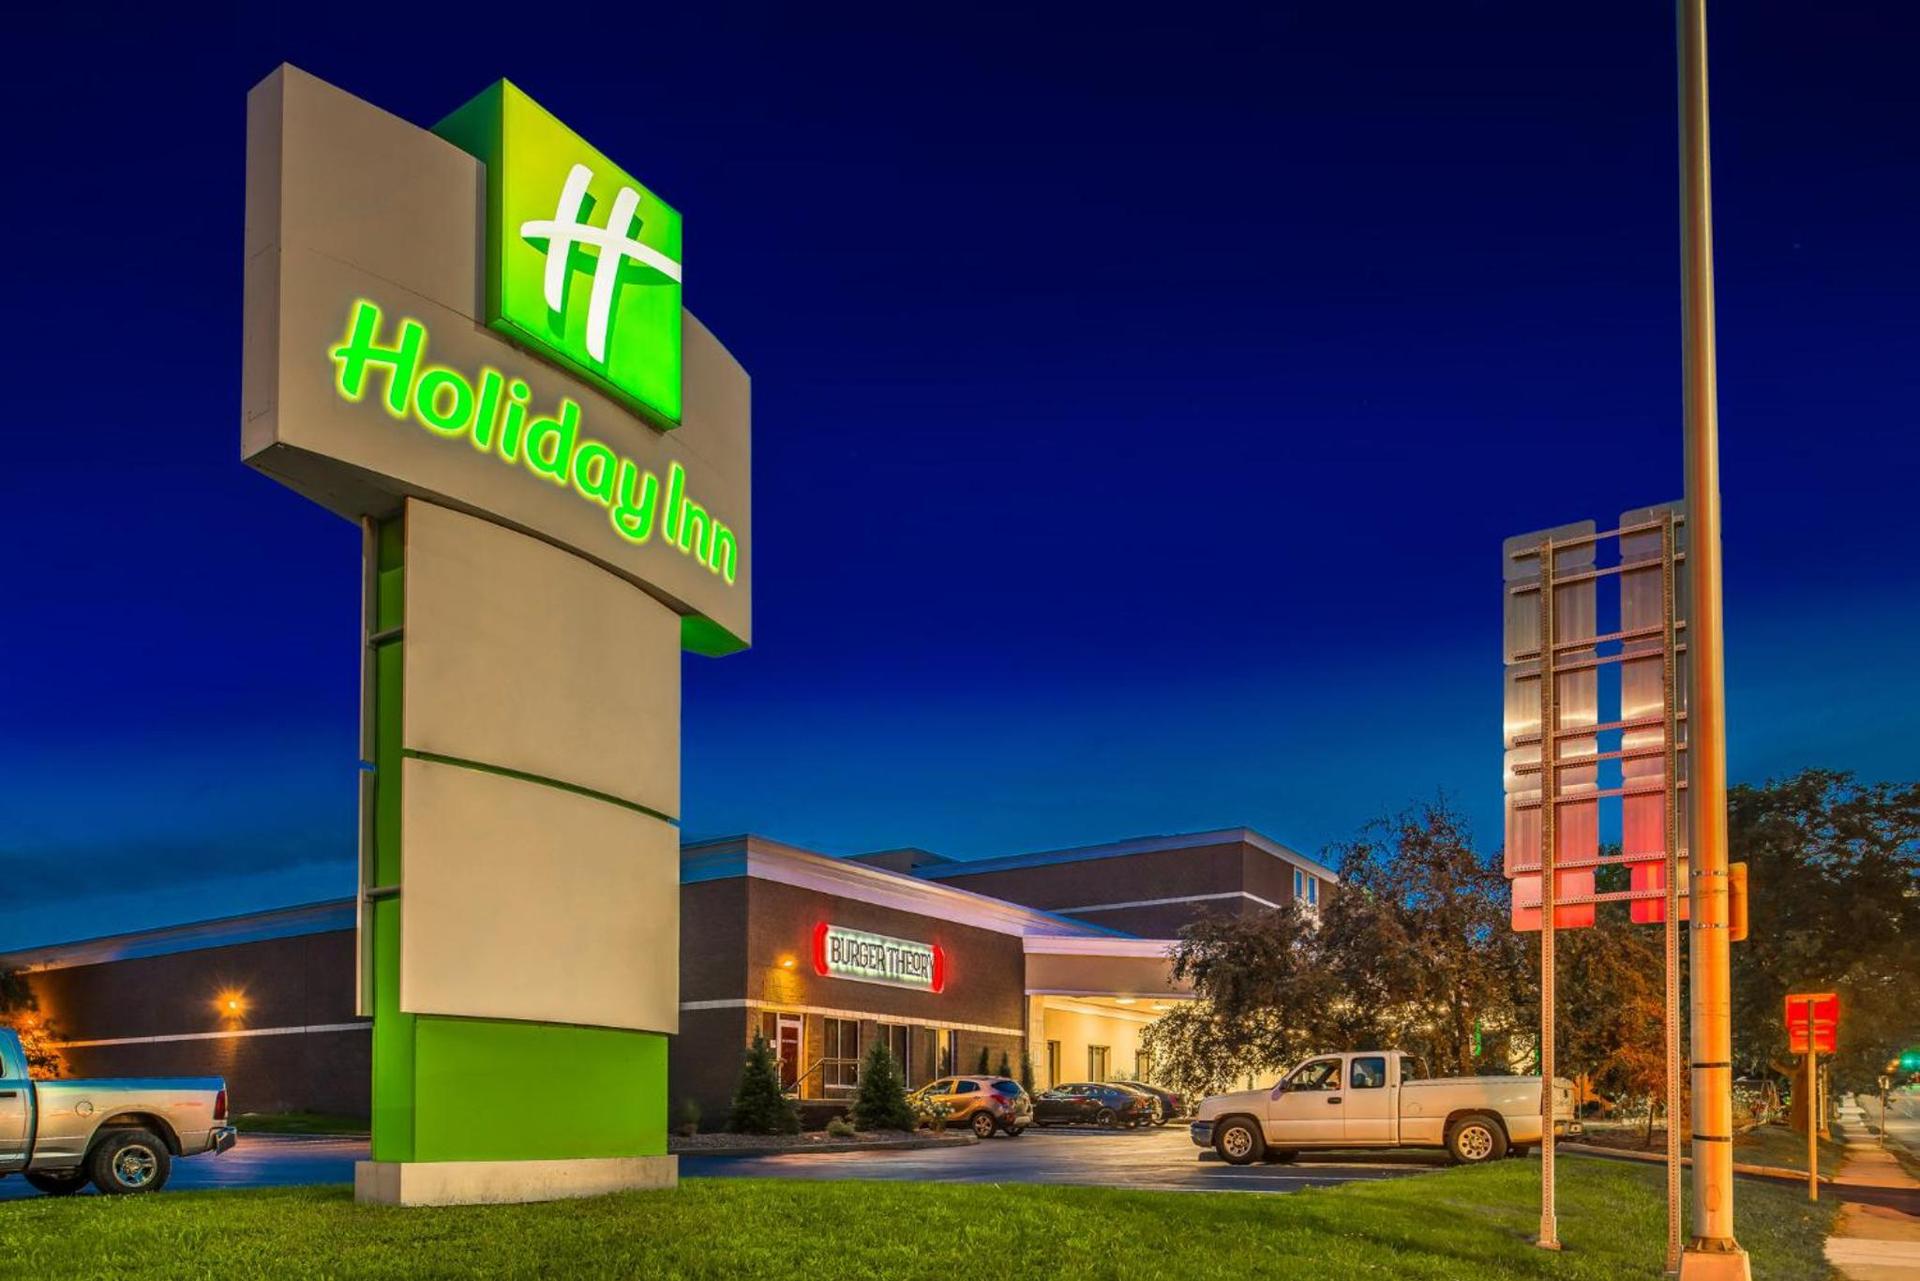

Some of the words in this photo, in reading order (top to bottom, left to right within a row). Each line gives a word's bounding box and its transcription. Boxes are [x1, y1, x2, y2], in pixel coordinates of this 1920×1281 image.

[520, 163, 682, 364] H
[331, 301, 658, 542] Holiday
[664, 464, 737, 582] Inn
[830, 936, 886, 971] BURGER
